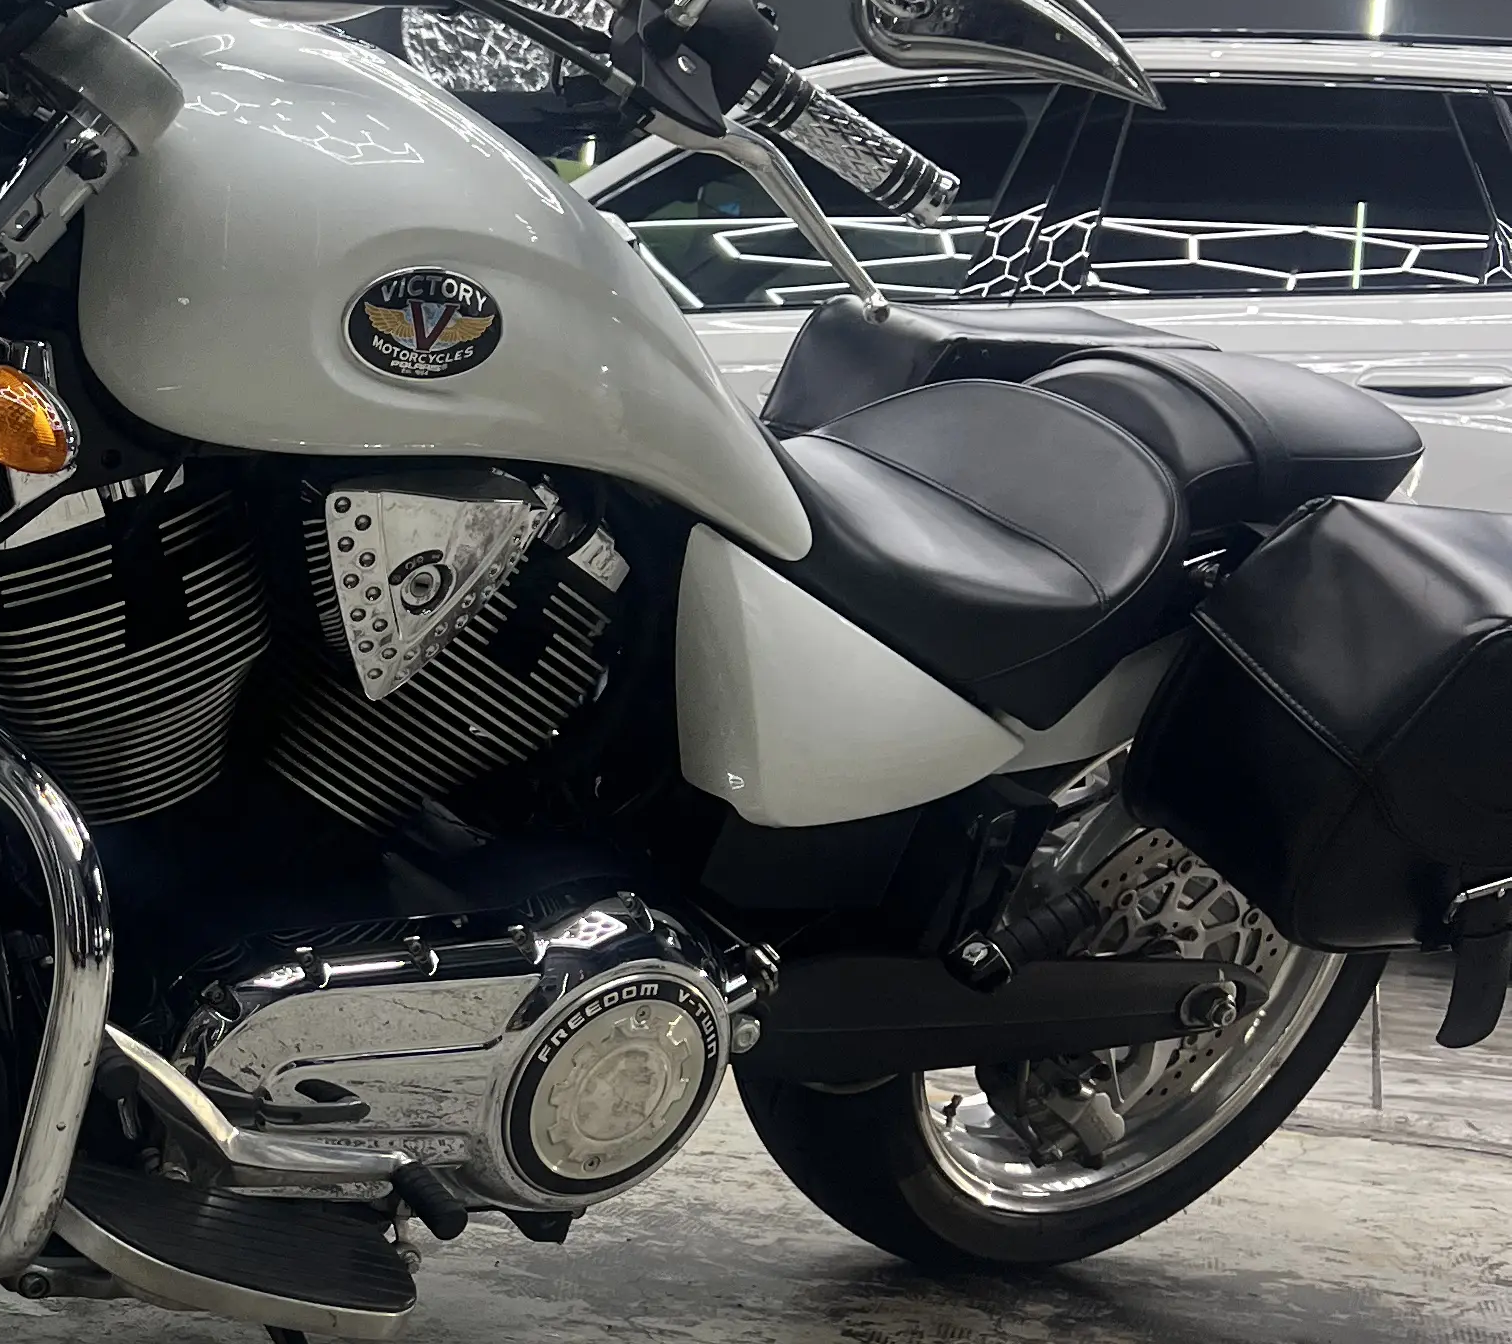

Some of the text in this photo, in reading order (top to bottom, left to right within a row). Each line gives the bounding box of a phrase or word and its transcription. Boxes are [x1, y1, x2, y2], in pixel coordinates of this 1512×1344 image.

[381, 275, 487, 312] VICTORY
[372, 334, 474, 364] MOTORCYCLES
[538, 983, 719, 1063] FREEDOM V-TWIN
